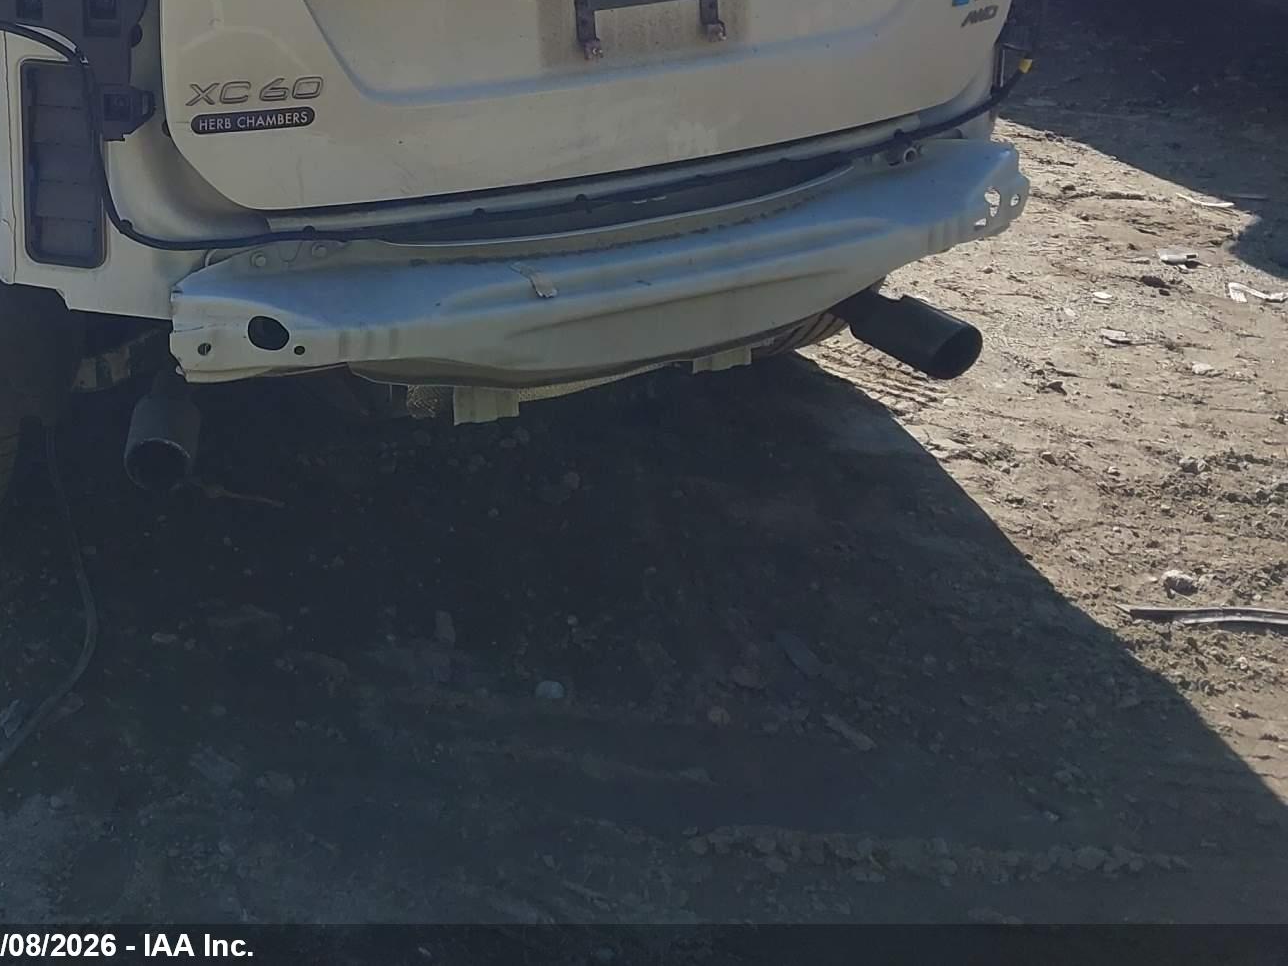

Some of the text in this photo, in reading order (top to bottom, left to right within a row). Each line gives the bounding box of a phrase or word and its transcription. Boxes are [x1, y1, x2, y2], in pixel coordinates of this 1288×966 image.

[960, 4, 1000, 28] AWD
[198, 110, 309, 132] HERB CHAMBERS
